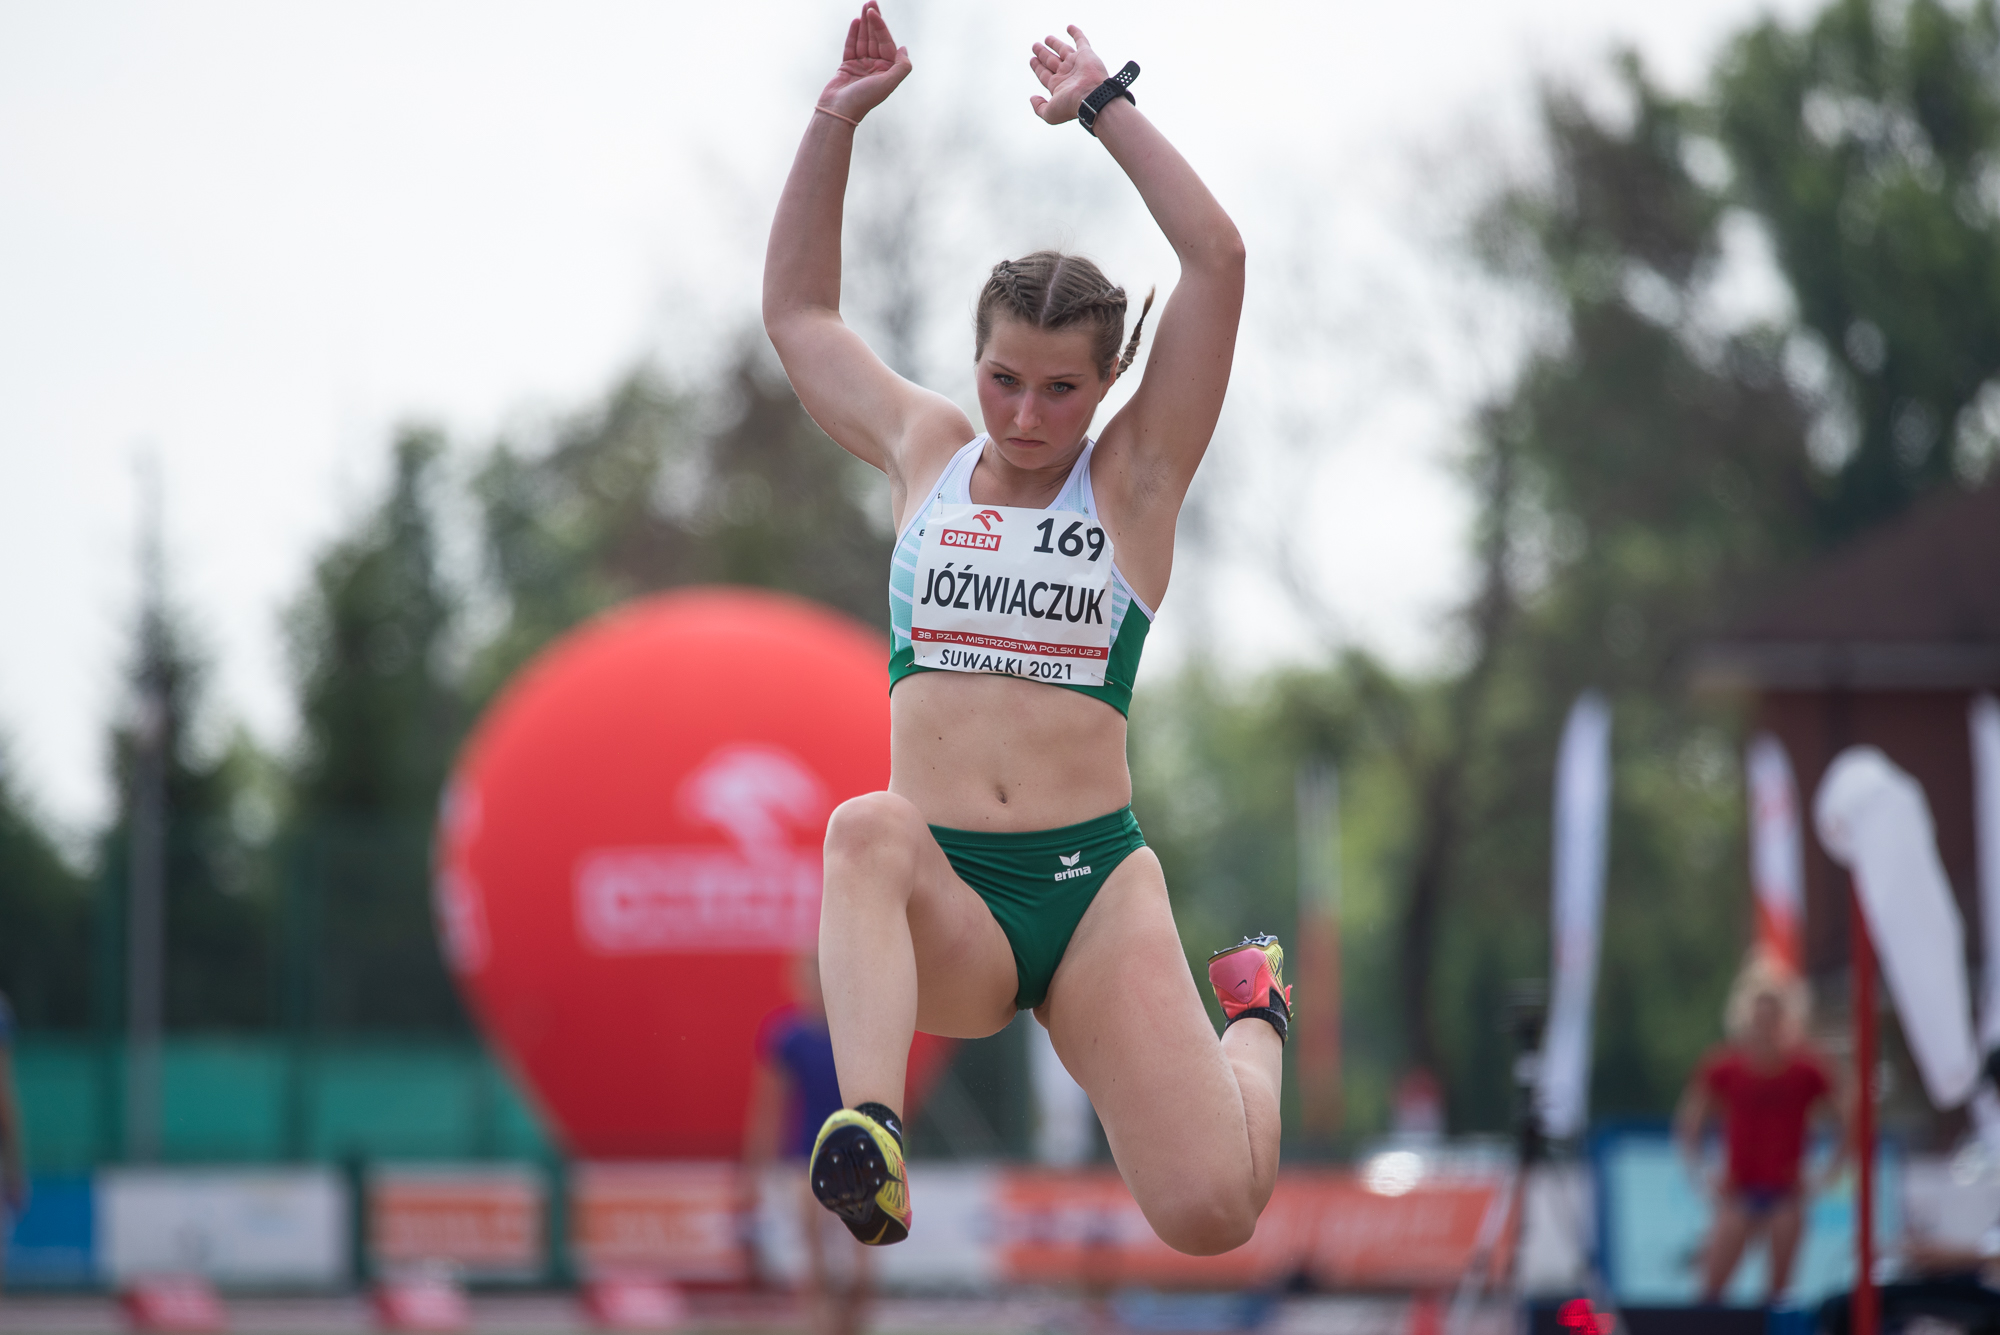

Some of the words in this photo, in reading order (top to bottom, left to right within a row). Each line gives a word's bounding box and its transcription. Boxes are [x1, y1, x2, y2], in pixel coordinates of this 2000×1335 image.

[944, 531, 998, 549] ORLEN
[1033, 517, 1105, 562] 169
[921, 562, 1106, 625] JÓŹWIACZUK
[917, 630, 934, 640] 38.
[936, 632, 964, 642] PZLA
[965, 635, 1037, 651] MISTRZOSTWA
[1039, 645, 1077, 655] POLSKI
[1078, 647, 1102, 657] U23
[939, 648, 1022, 675] SUWAŁKI
[1028, 660, 1072, 680] 2021
[1054, 866, 1092, 881] erima
